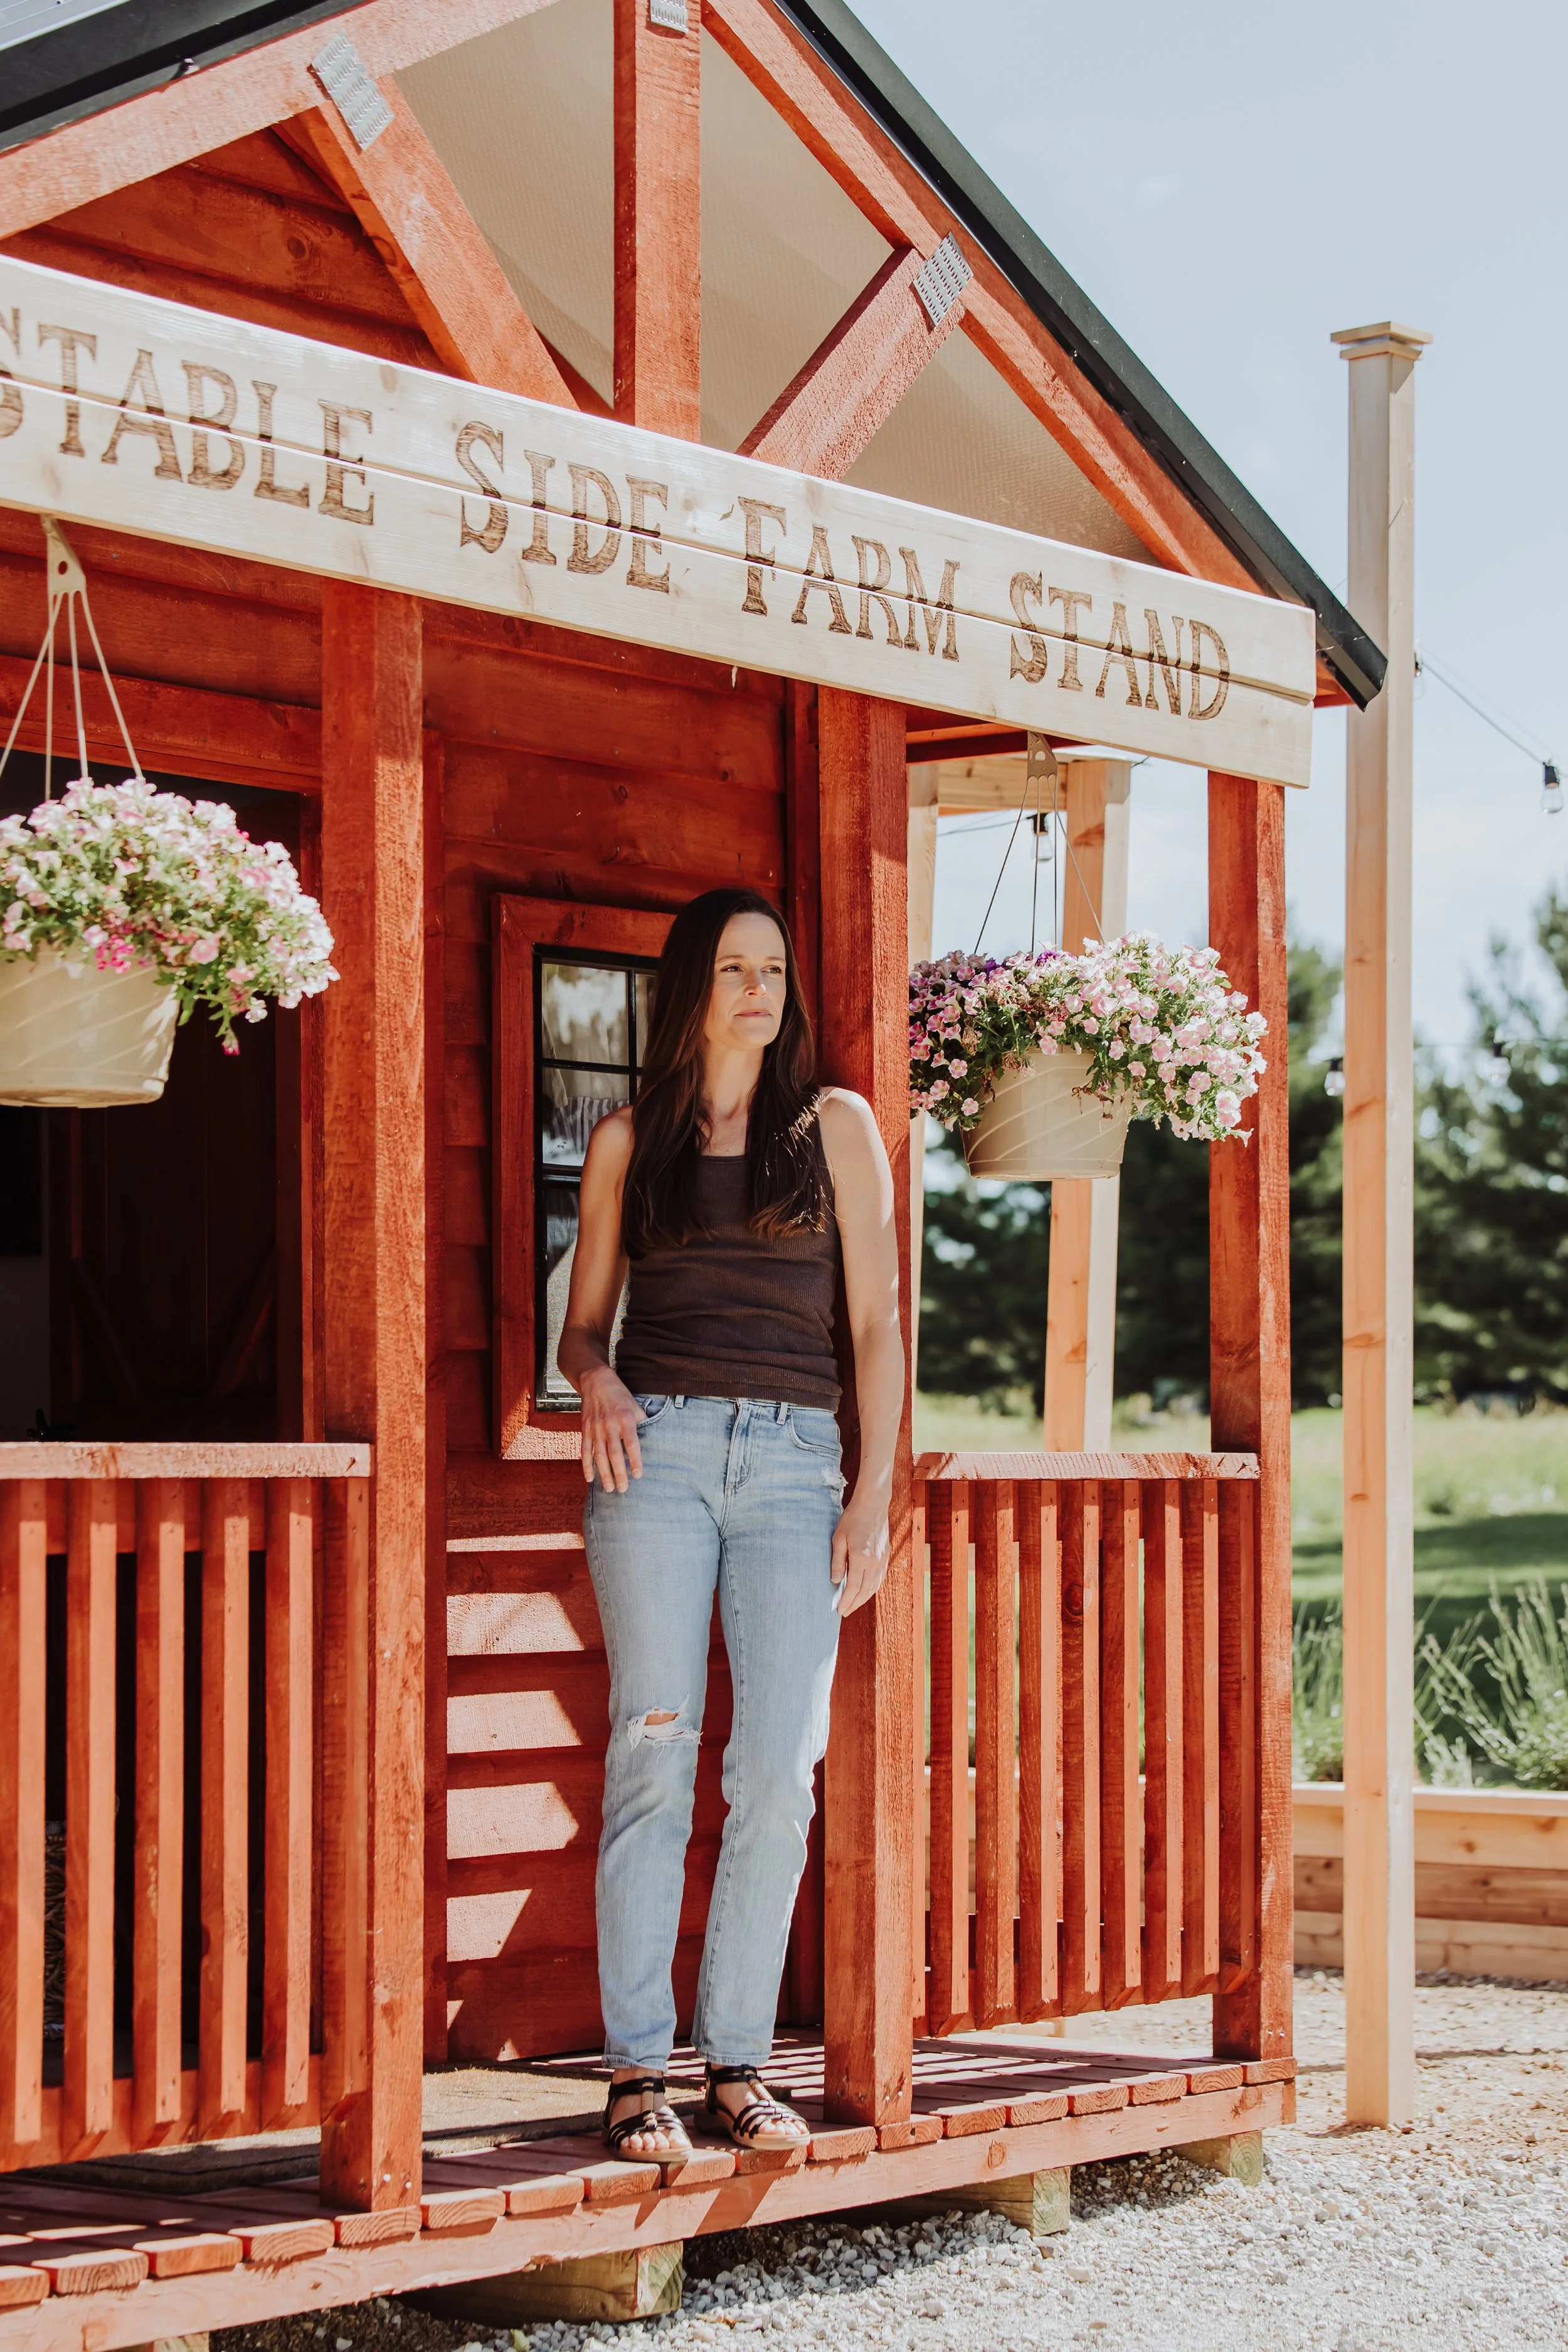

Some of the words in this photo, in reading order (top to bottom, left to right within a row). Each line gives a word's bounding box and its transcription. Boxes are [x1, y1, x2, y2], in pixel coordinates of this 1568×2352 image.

[455, 420, 669, 595] SIDE
[738, 496, 960, 662] FARM
[1009, 570, 1230, 721] STAND
